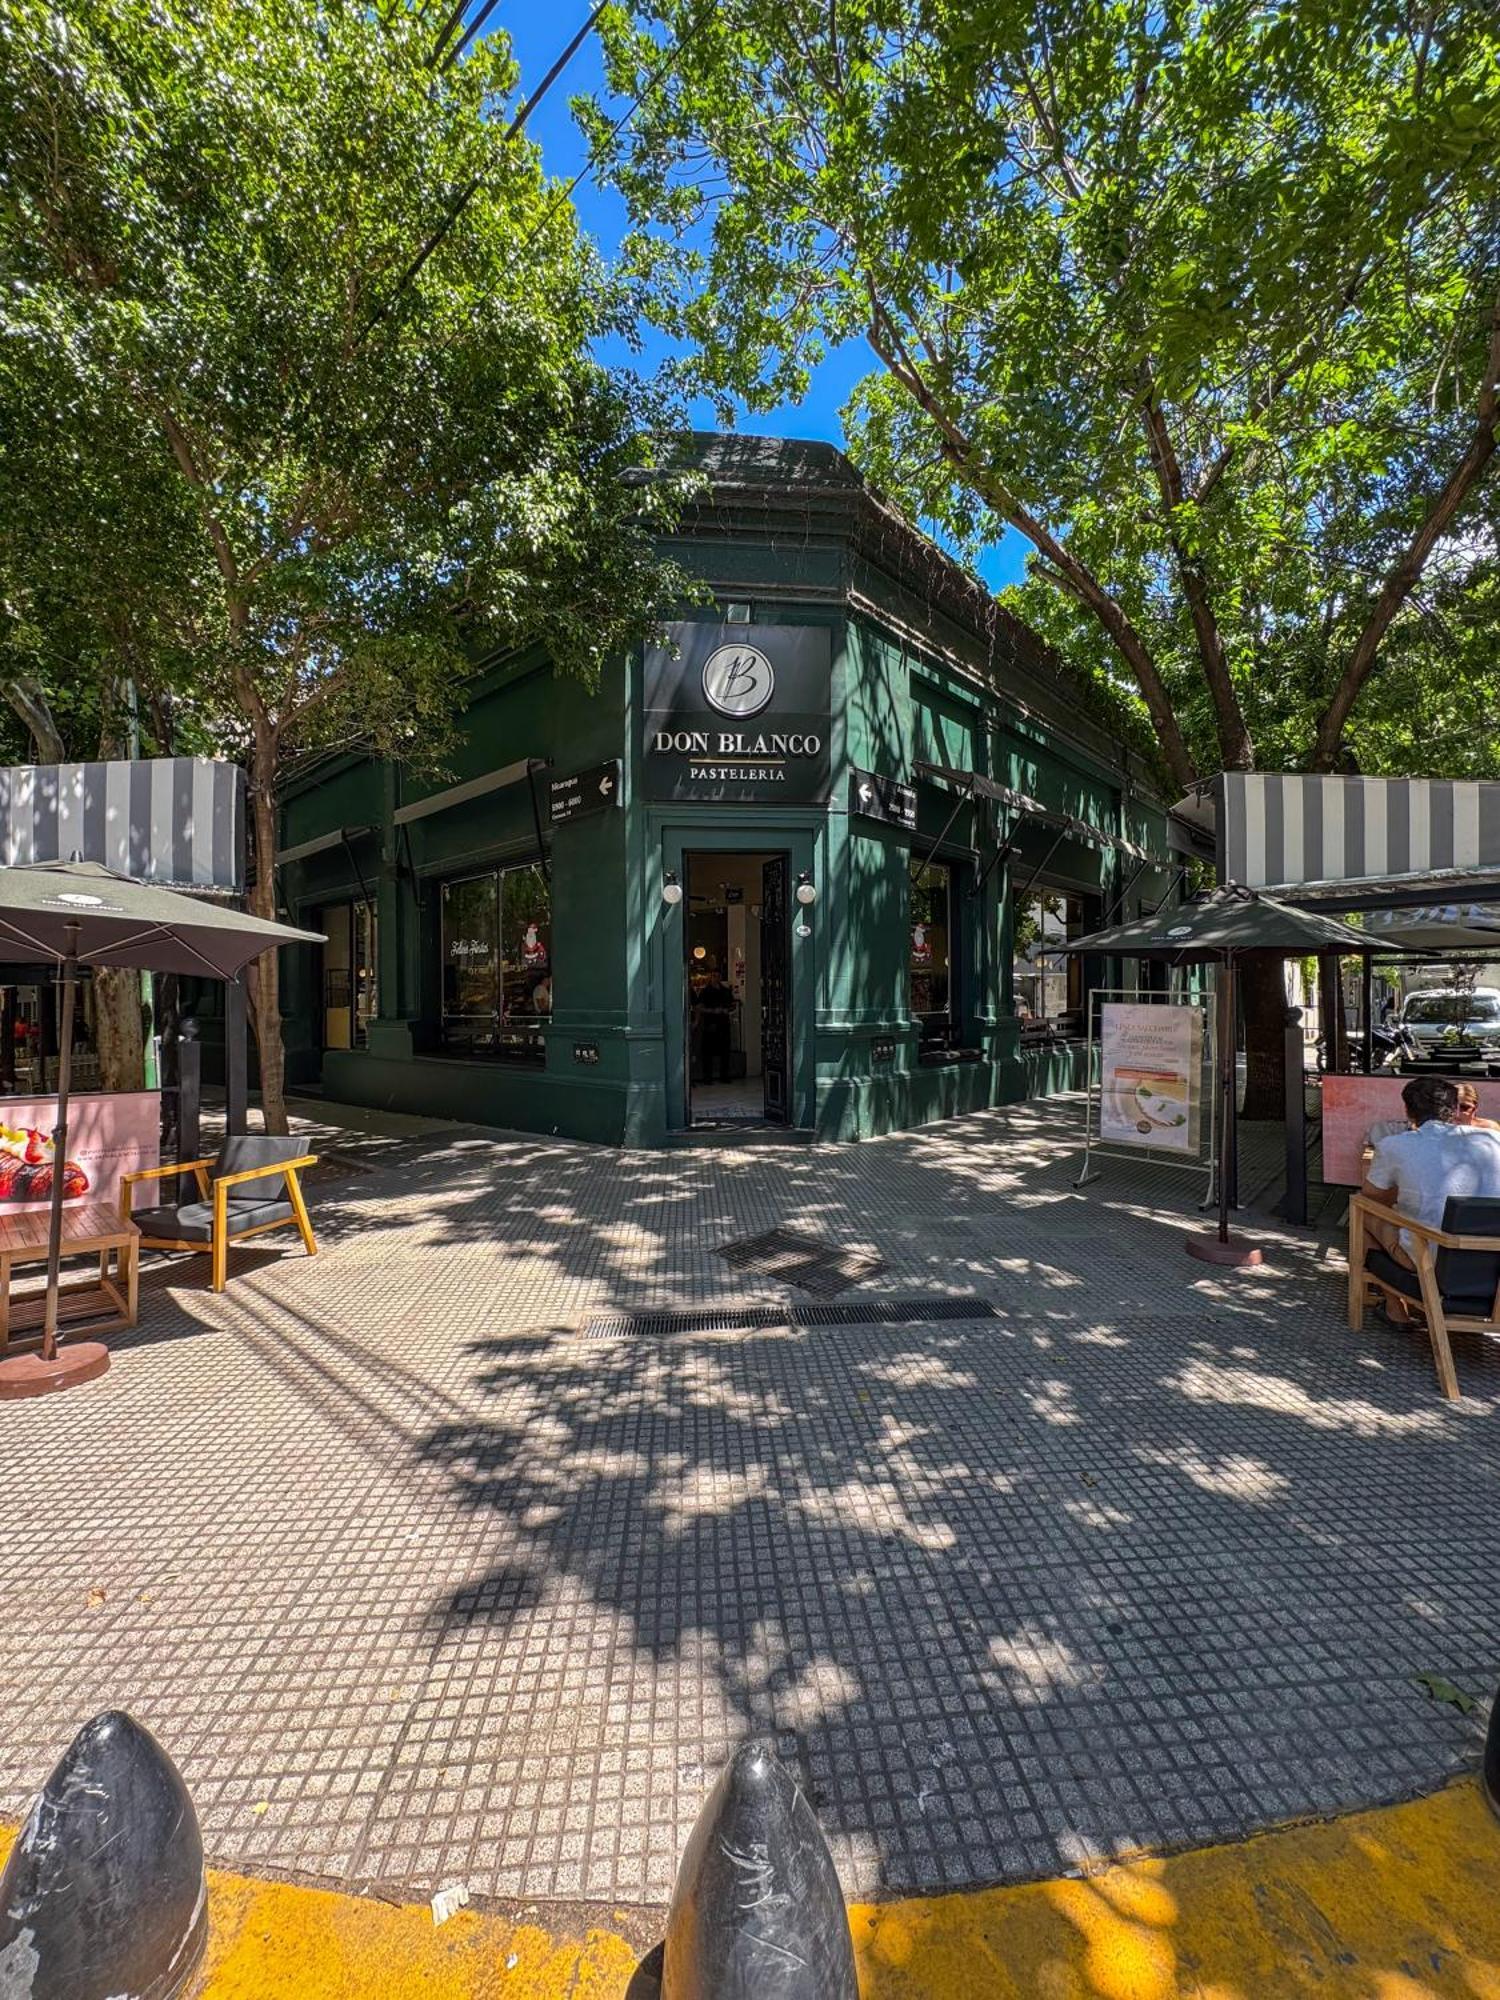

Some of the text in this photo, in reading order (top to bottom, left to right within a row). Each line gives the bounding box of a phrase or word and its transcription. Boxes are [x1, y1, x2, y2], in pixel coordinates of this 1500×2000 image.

[656, 732, 821, 754] DON BLANCO
[690, 767, 785, 780] PASTELERIA
